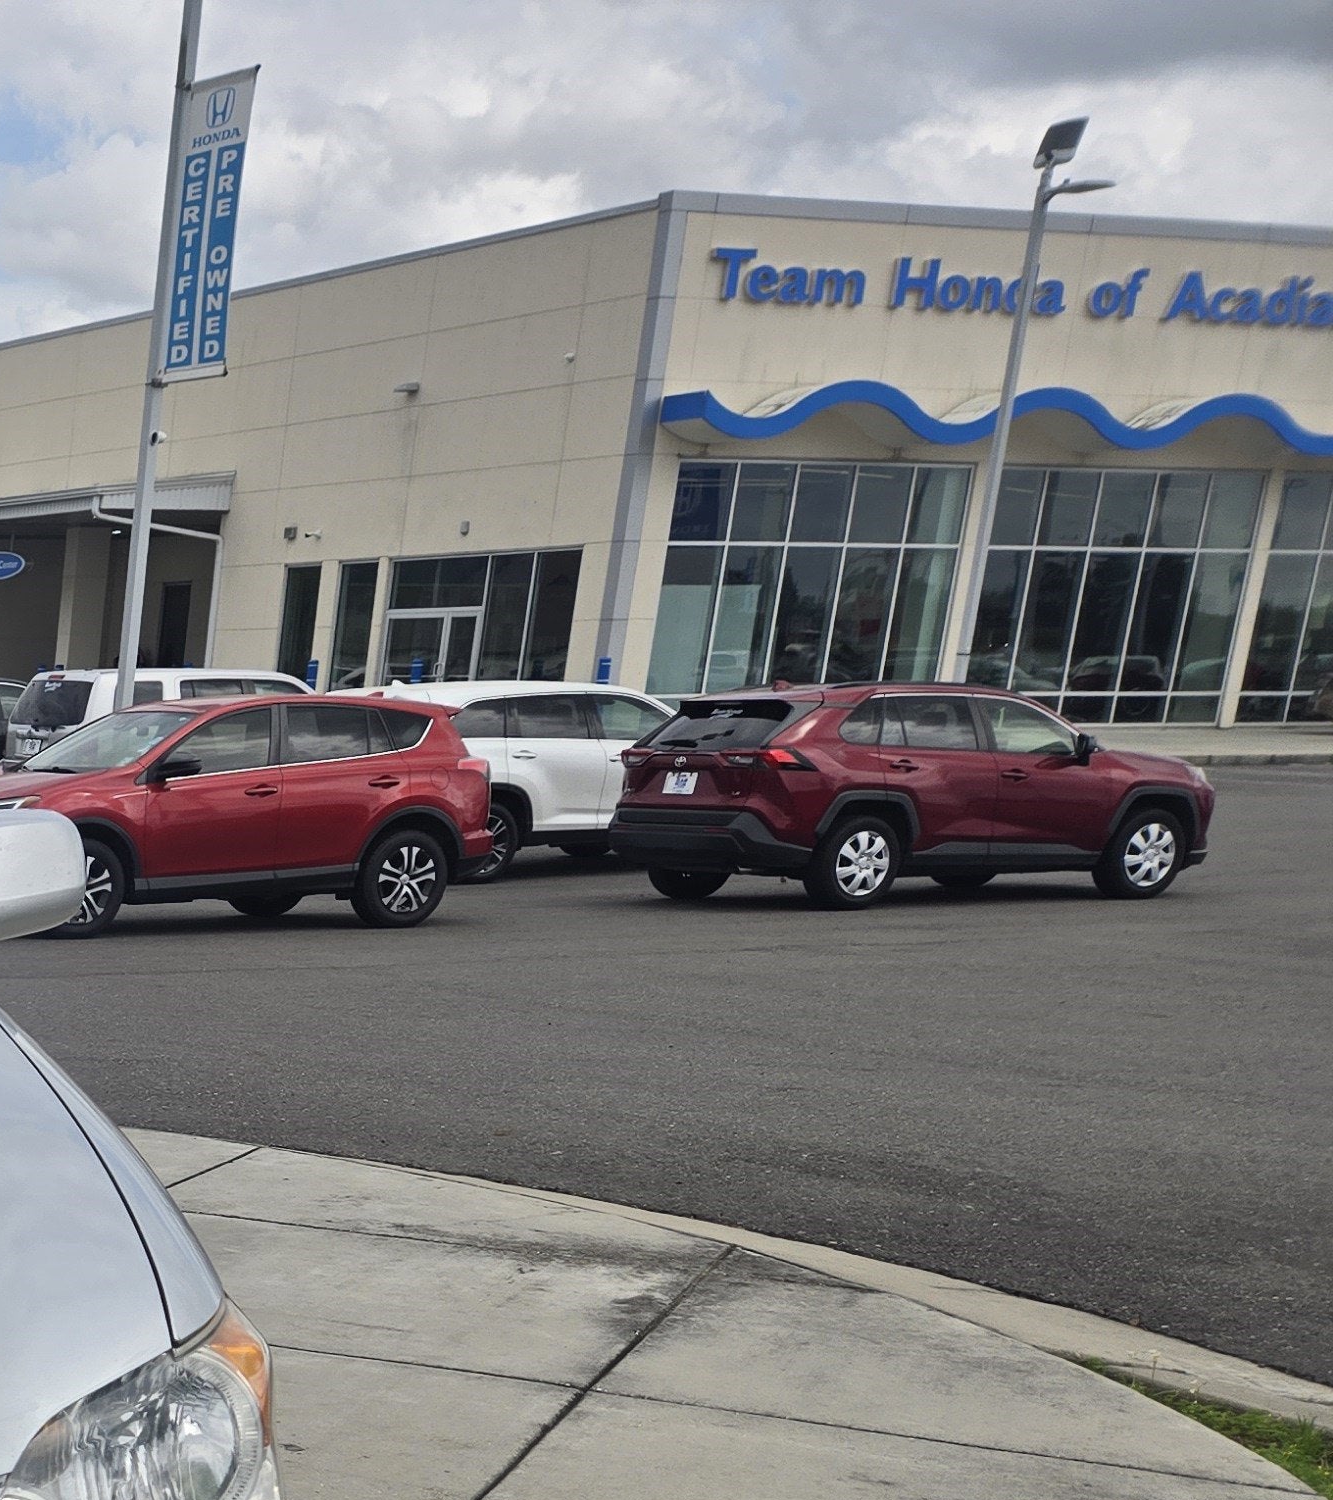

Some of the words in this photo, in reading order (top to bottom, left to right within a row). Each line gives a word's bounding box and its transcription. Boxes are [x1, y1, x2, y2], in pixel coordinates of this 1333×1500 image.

[192, 127, 242, 149] HONDA
[215, 149, 238, 219] PRE
[170, 157, 207, 364] CERTIFIED
[713, 247, 867, 306] Team
[1089, 267, 1151, 319] of
[203, 245, 229, 359] OWNED
